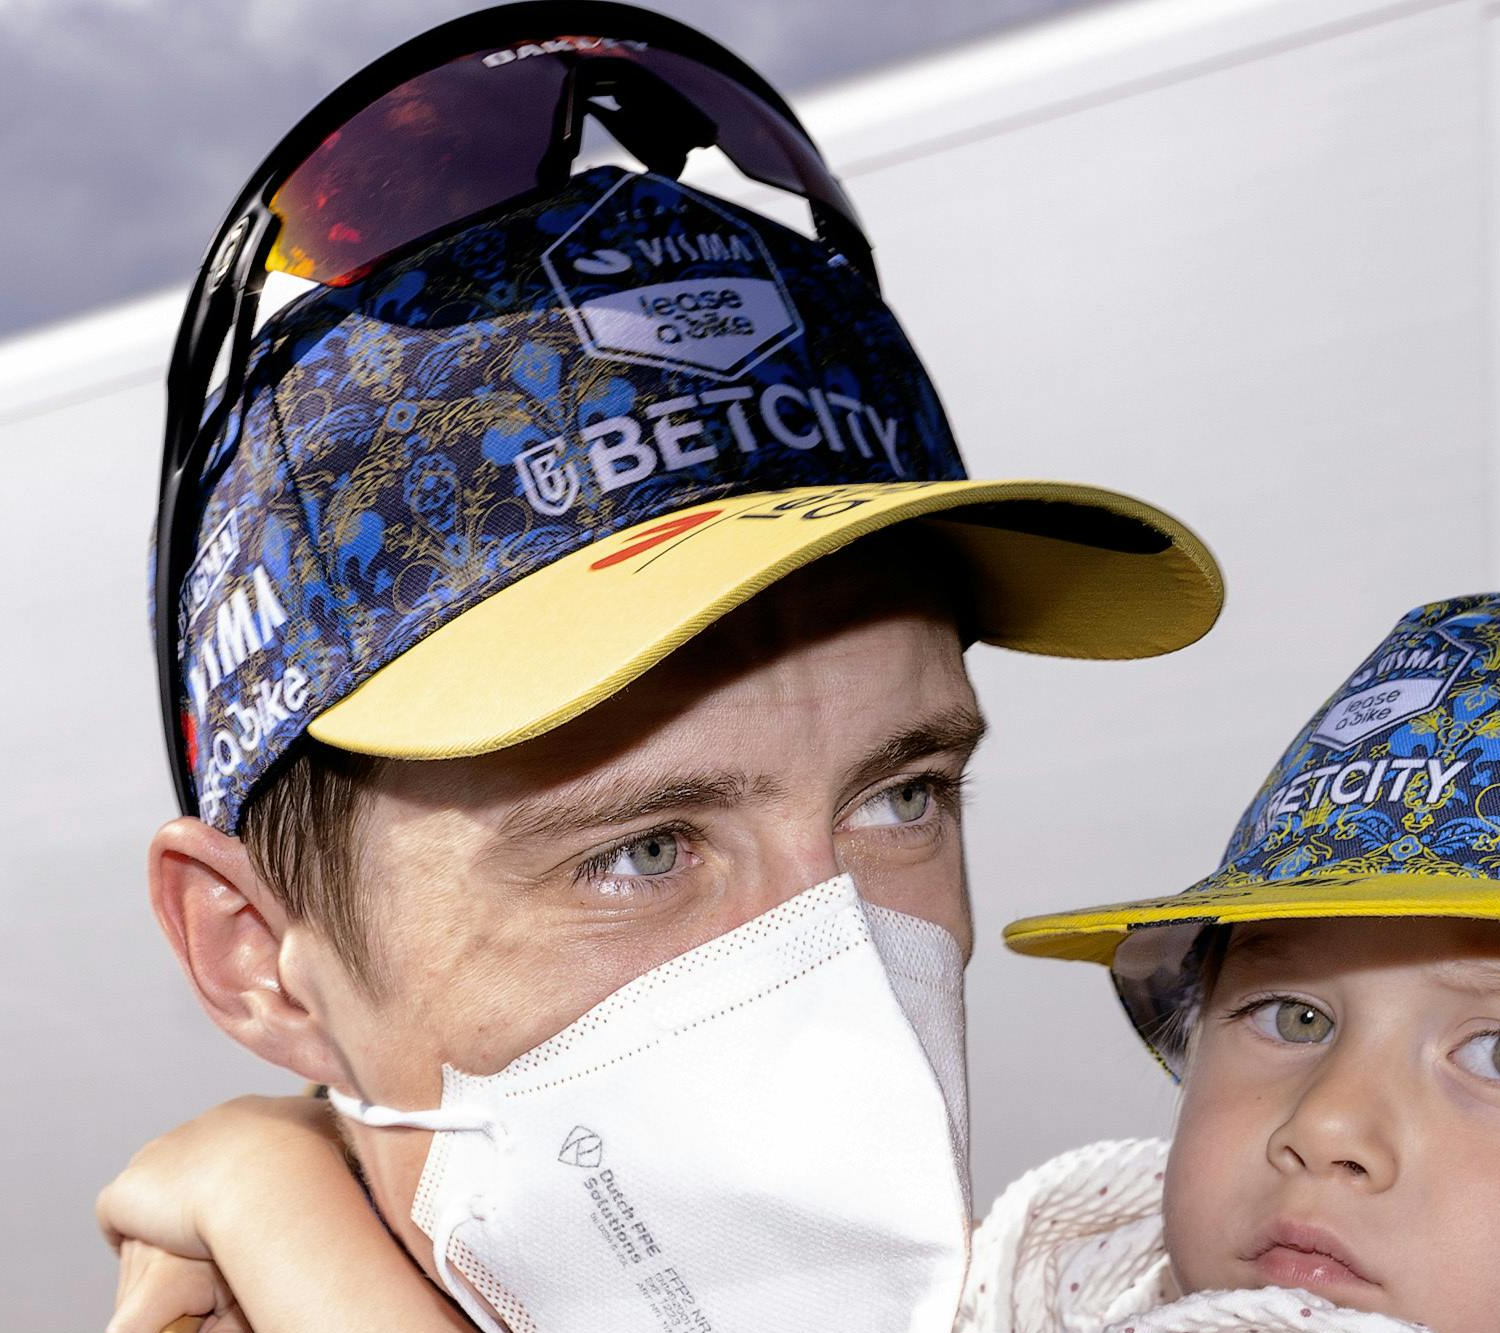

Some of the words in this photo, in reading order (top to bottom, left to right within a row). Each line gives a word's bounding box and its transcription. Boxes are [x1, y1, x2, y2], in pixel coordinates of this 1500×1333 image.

[636, 232, 755, 267] VISMA
[638, 288, 743, 318] lease
[582, 383, 906, 495] BETCITY
[1377, 648, 1447, 676] VISMA
[1344, 690, 1401, 714] lease
[584, 1176, 642, 1265] Solutions
[599, 1169, 636, 1221] Dutch
[631, 1221, 661, 1258] PPE
[663, 1267, 693, 1306] FFP2
[691, 1308, 712, 1333] NR
